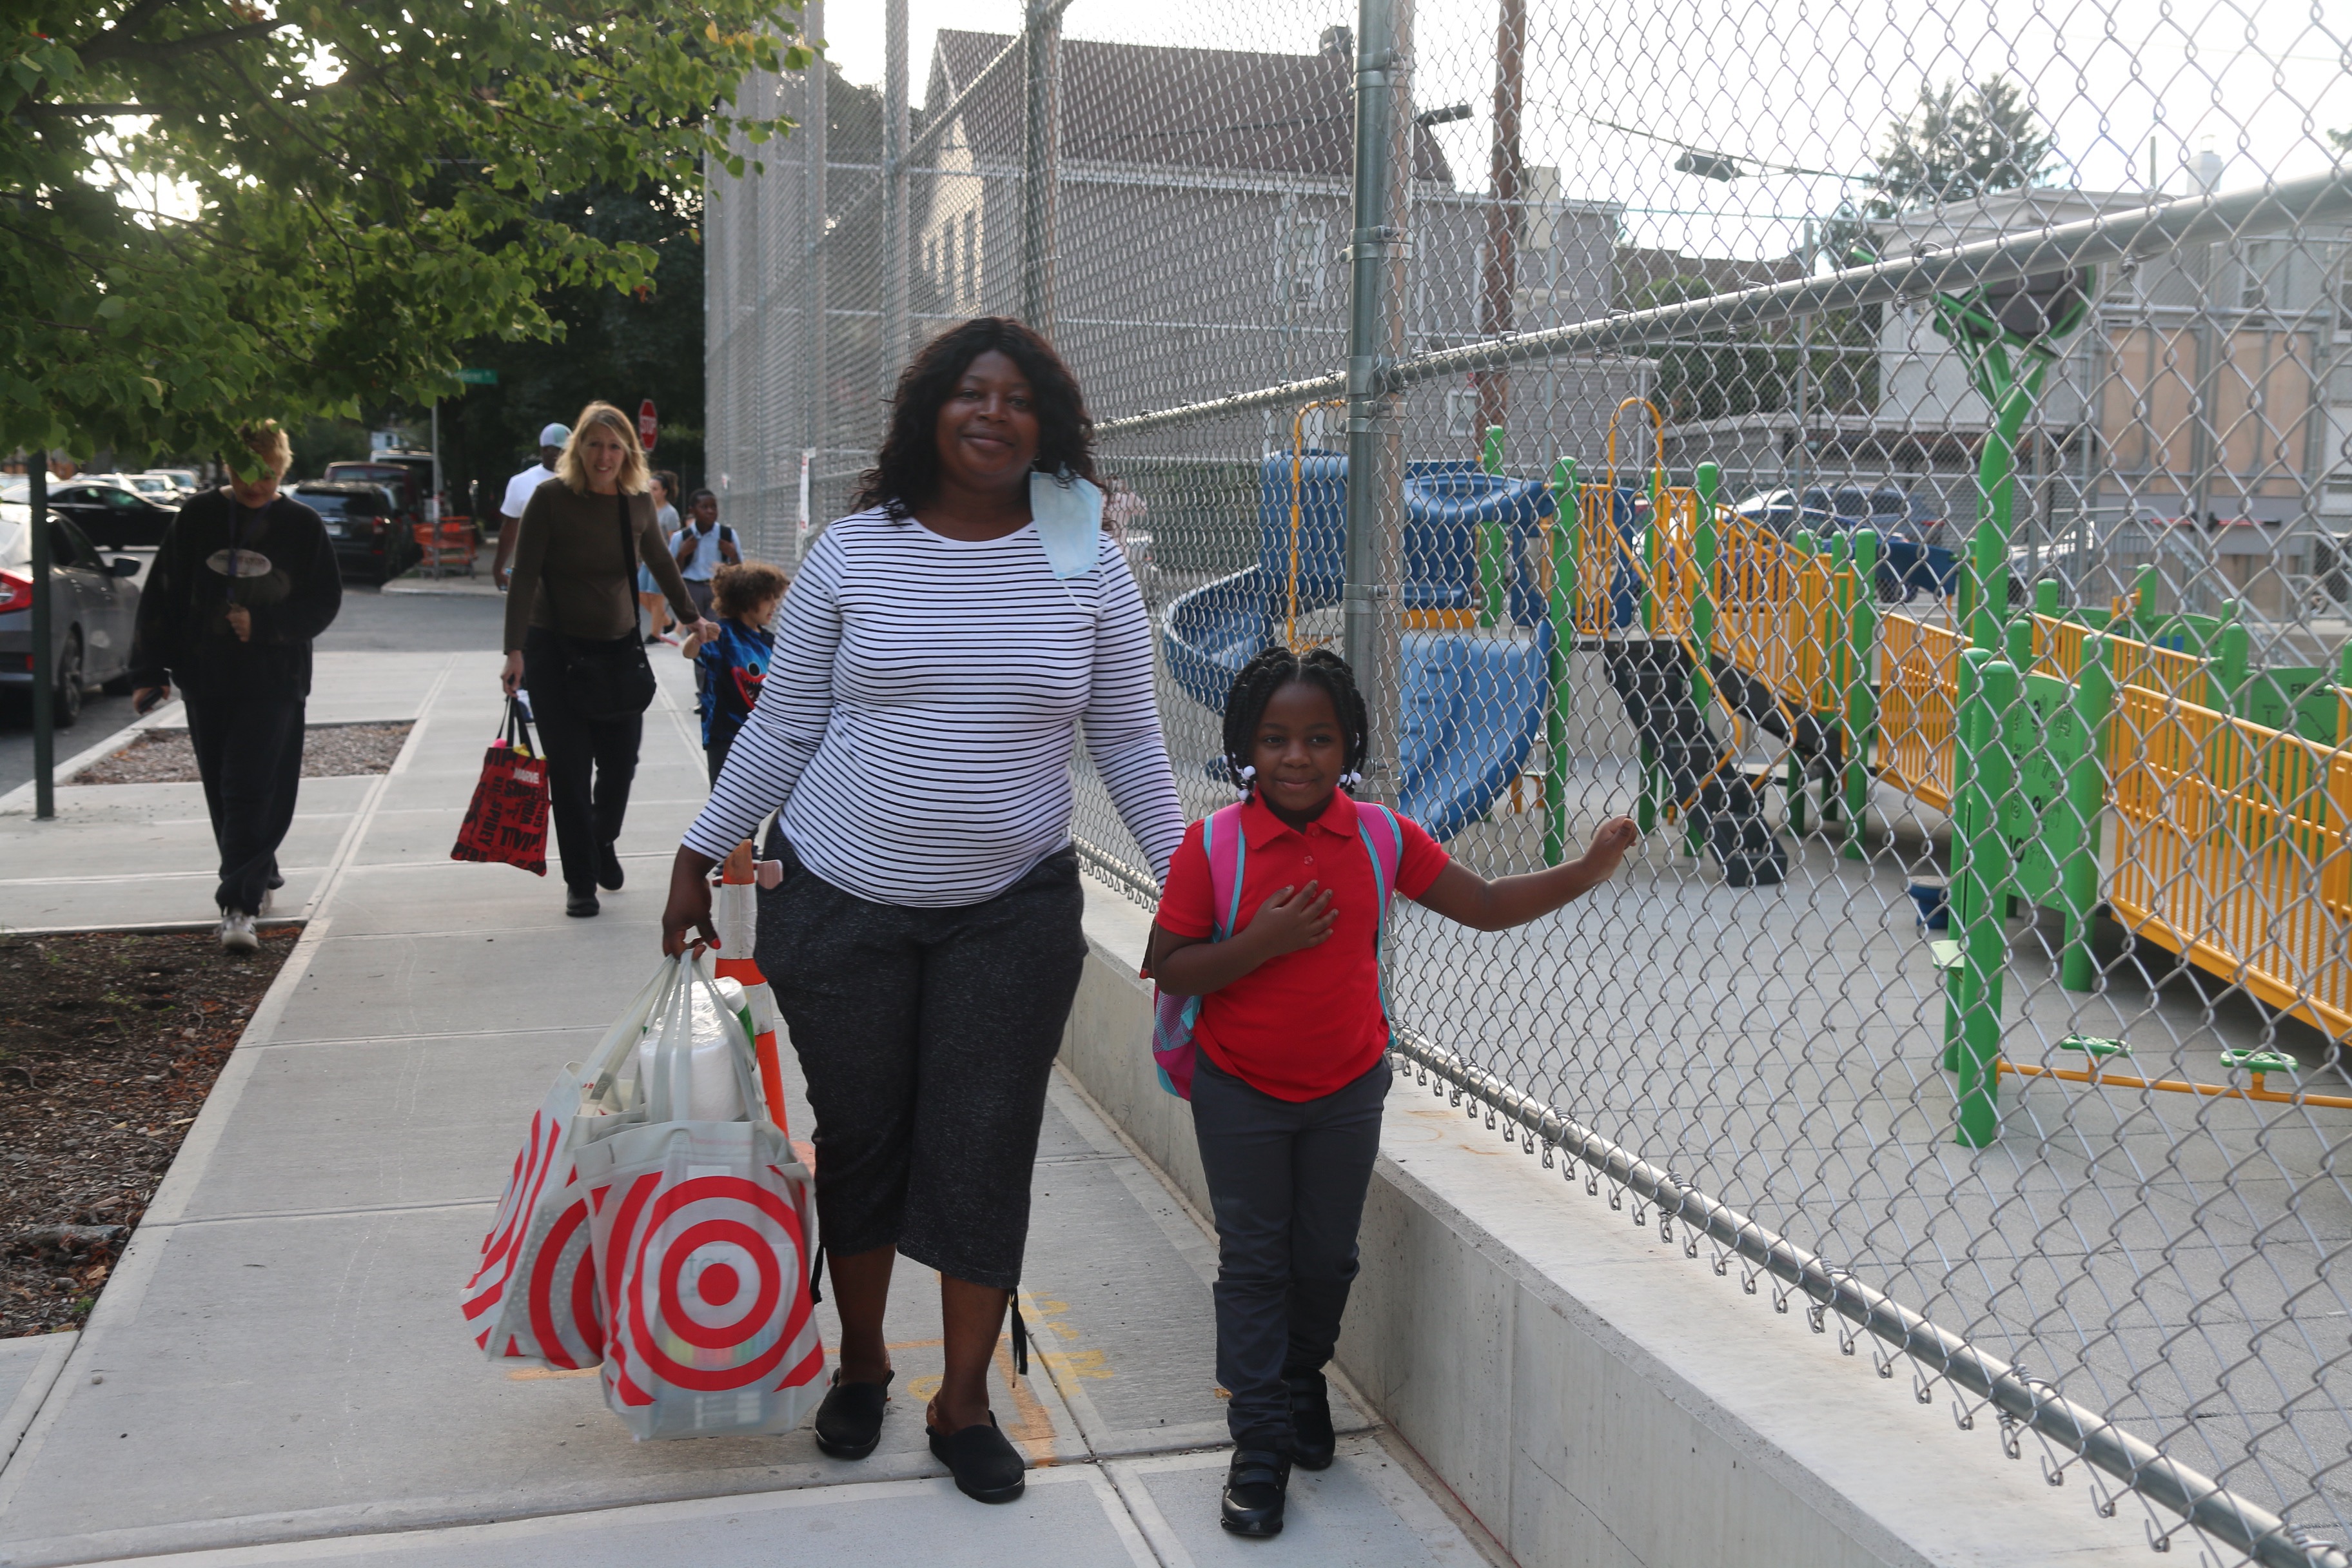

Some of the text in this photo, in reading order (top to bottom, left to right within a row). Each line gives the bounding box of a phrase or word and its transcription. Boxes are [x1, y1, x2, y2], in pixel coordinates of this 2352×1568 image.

[640, 415, 657, 435] STOP
[512, 767, 540, 785] MARVE
[478, 801, 502, 847] SPIDEY
